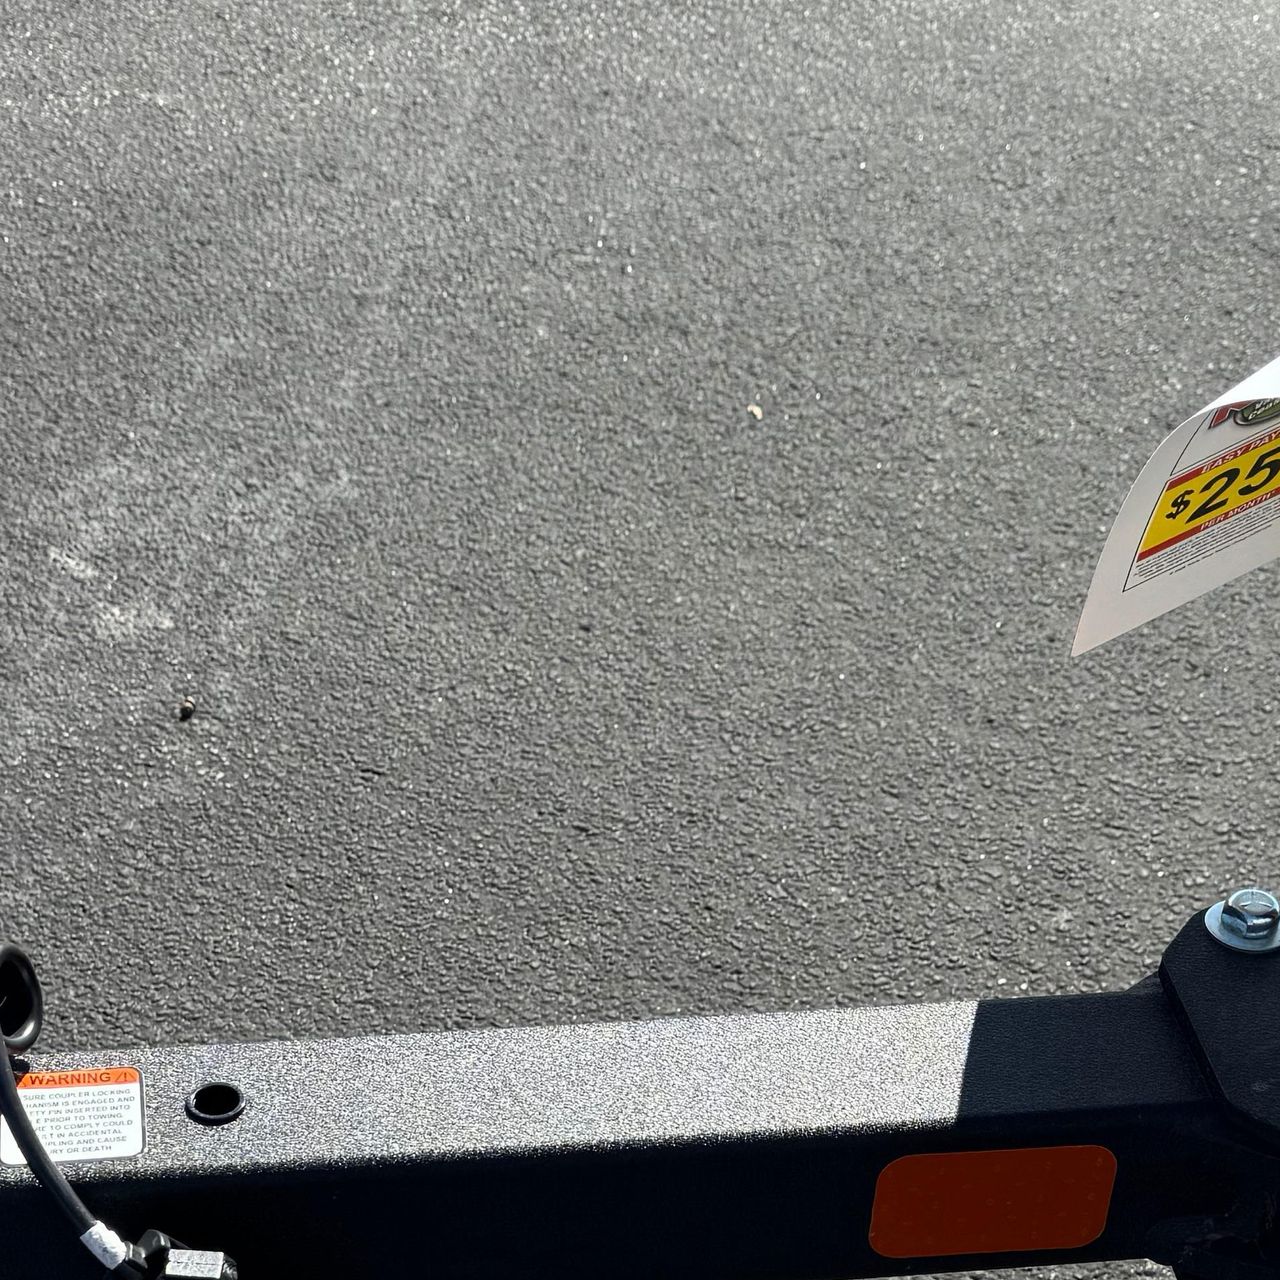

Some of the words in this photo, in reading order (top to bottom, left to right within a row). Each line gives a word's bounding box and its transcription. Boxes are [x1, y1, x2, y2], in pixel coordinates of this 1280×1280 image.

[29, 1072, 111, 1085] WARNING
[49, 1092, 90, 1100] COUPLER
[92, 1089, 131, 1097] LOCKING
[72, 1098, 115, 1106] ENGAGED
[65, 1106, 108, 1114] INSERTED
[64, 1122, 100, 1130] COMPLY
[68, 1129, 123, 1138] ACCIDENTAL
[82, 1145, 112, 1153] DEATH
